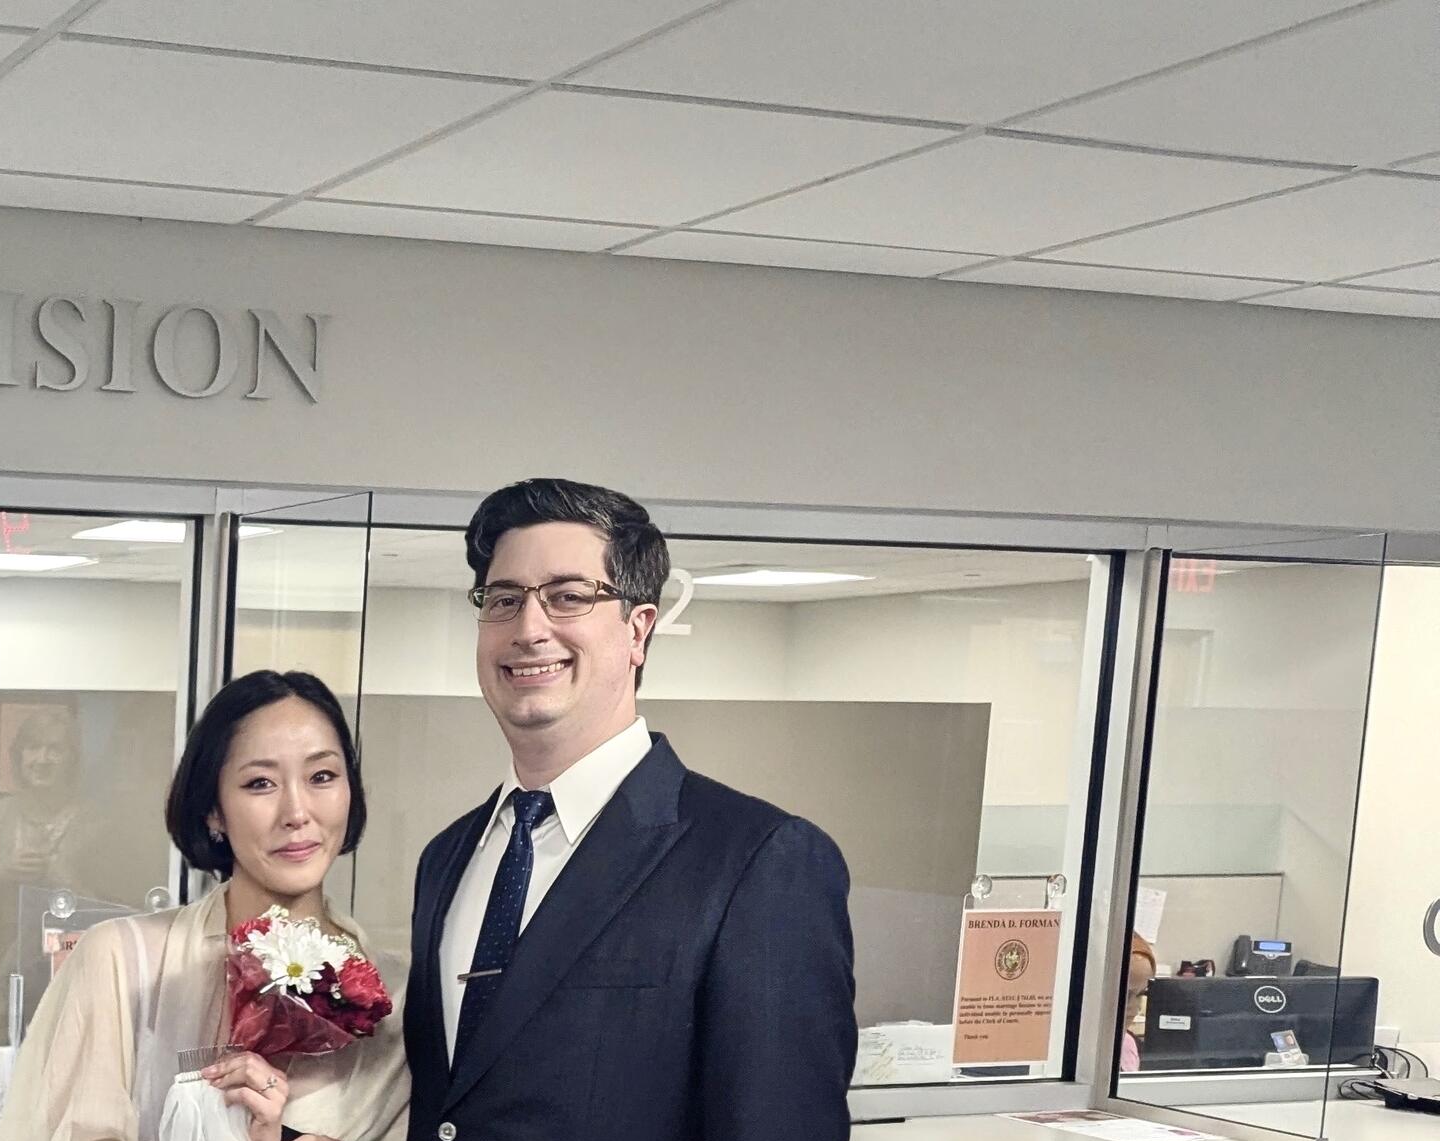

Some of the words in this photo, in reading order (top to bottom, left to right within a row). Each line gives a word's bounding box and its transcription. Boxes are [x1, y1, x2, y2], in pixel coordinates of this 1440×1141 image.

[653, 567, 694, 635] 2
[968, 919, 1006, 929] BRENDA
[1008, 919, 1017, 928] D.
[1019, 918, 1060, 928] FORMAN
[1258, 995, 1283, 1003] DELL
